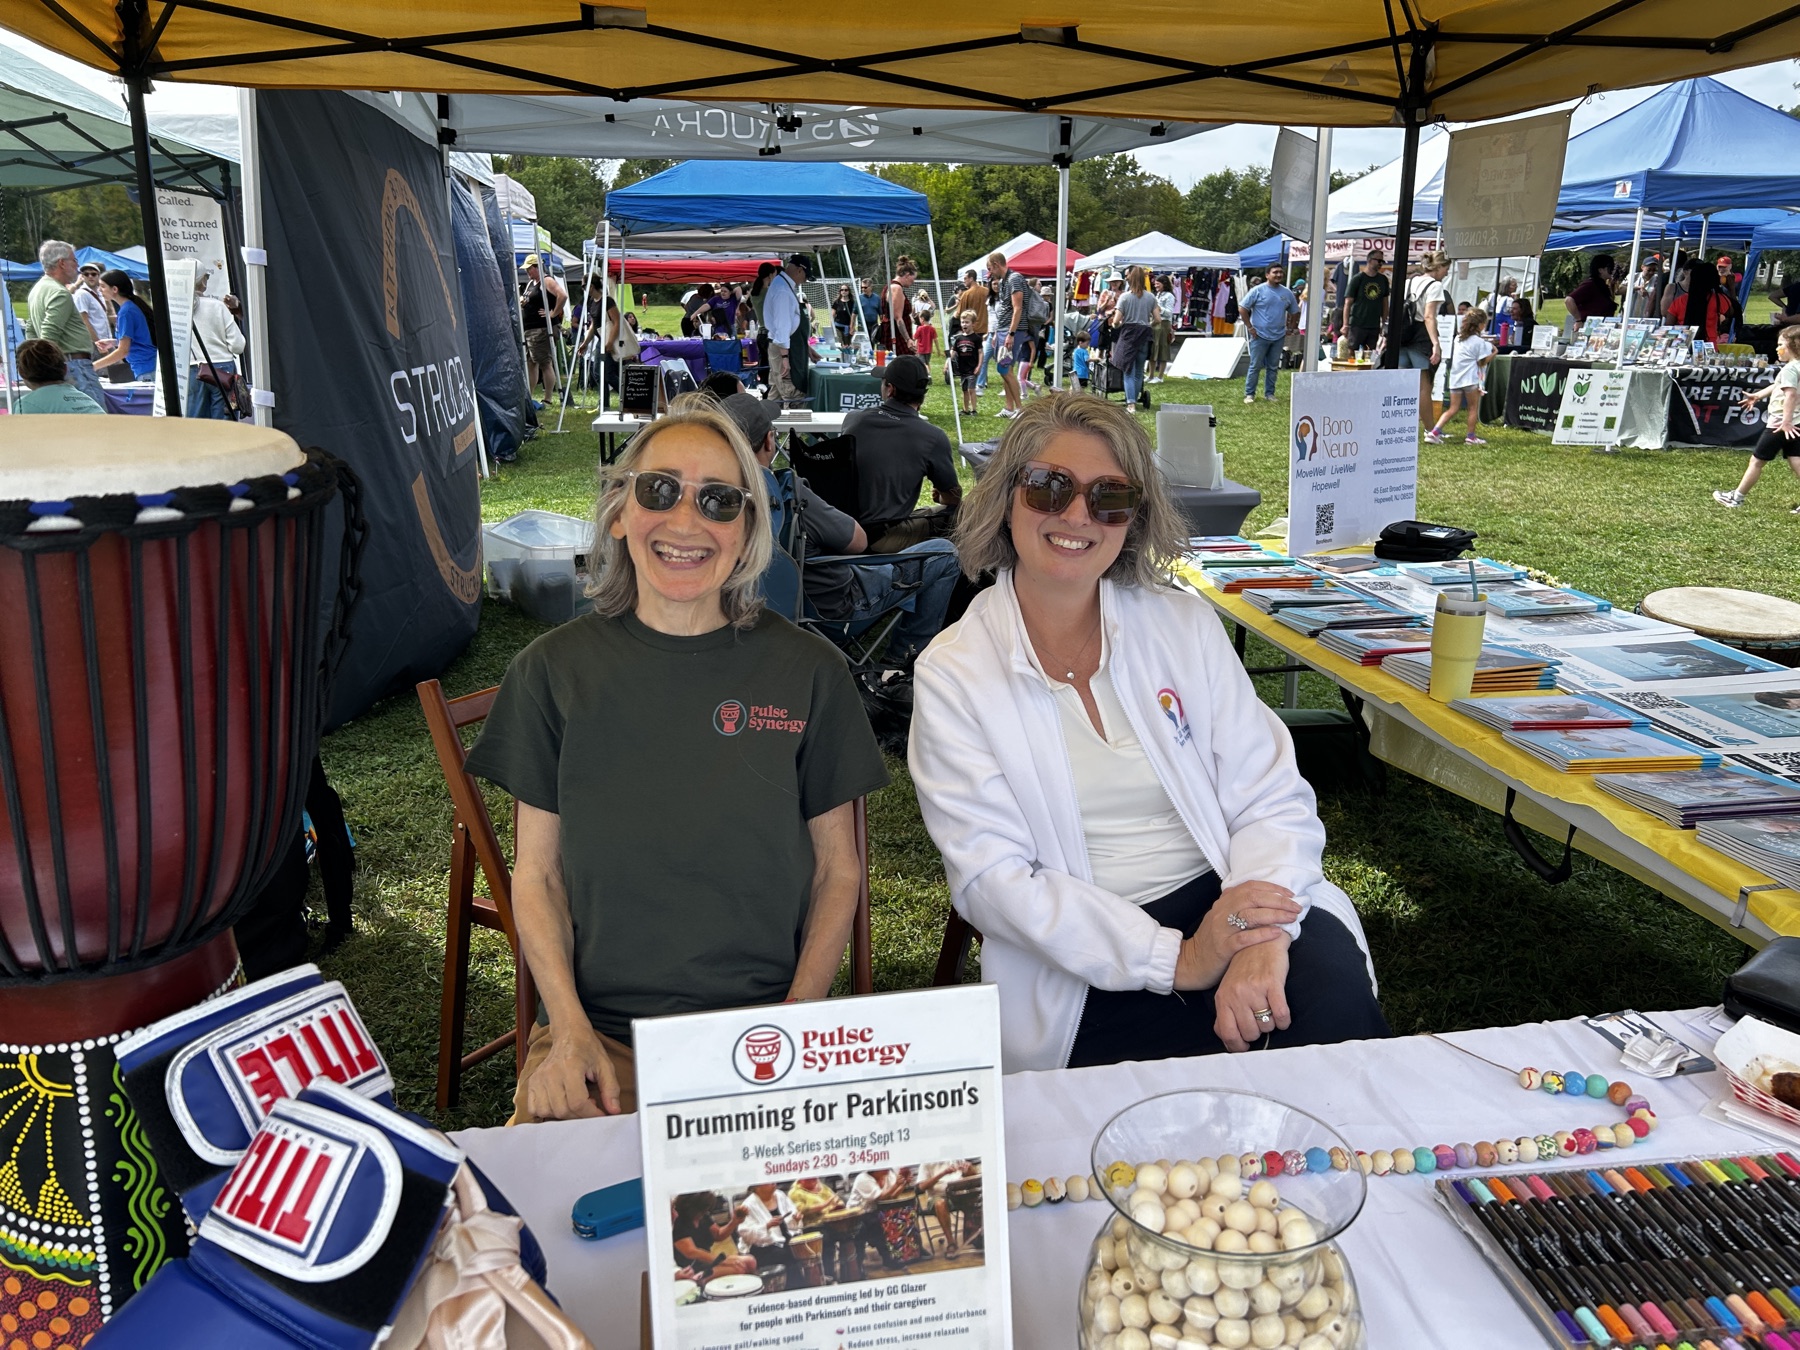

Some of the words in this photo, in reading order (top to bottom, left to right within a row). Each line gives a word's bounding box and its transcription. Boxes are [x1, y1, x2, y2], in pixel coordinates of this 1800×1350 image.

[158, 196, 194, 206] Called.
[160, 218, 178, 228] We
[178, 218, 218, 229] Turned
[162, 231, 180, 240] the
[182, 231, 210, 242] Light
[1362, 238, 1424, 251] DOUE
[164, 242, 198, 253] Down.
[1520, 375, 1537, 394] NJ
[1577, 373, 1594, 382] NJ
[1382, 396, 1392, 408] Jill
[1393, 396, 1417, 406] Farmer
[1382, 410, 1390, 419] DO,
[1391, 409, 1404, 418] MPH,
[1404, 408, 1417, 417] FCPP
[1723, 406, 1769, 426] FOO
[1322, 416, 1353, 436] Boro
[1322, 439, 1358, 459] Neuro
[1373, 456, 1415, 466] info@boroneuro.com
[1296, 466, 1326, 479] MoveWell
[1331, 463, 1356, 475] LiveWell
[1374, 465, 1415, 475] www.boroneuro.com
[1312, 479, 1340, 494] Hopewell
[1380, 486, 1388, 494] East
[1389, 484, 1401, 493] Broad
[750, 704, 788, 718] Pulse
[748, 716, 807, 733] Synergy
[802, 1026, 874, 1050] Pulse
[236, 1010, 379, 1116] TITLE
[802, 1042, 912, 1072] Synergy
[666, 1104, 796, 1140] Drumming
[804, 1098, 838, 1124] for
[846, 1081, 980, 1120] Parkinson's
[742, 1144, 785, 1161] 8-Week
[787, 1140, 821, 1156] Series
[824, 1135, 867, 1153] starting
[869, 1130, 894, 1148] Sept
[897, 1128, 910, 1142] 13
[764, 1158, 810, 1176] Sundays
[813, 1153, 838, 1168] 2:30
[849, 1149, 890, 1166] 3:45pm
[748, 1296, 813, 1316] Evidence-based
[815, 1291, 858, 1306] drumming
[859, 1288, 873, 1300] led
[874, 1287, 884, 1299] by
[901, 1283, 927, 1294] Glazer
[740, 1319, 752, 1331] for
[755, 1317, 783, 1331] people
[785, 1313, 803, 1324] with
[805, 1305, 852, 1322] Parkinson's
[854, 1305, 869, 1316] and
[871, 1302, 891, 1313] their
[893, 1296, 936, 1310] caregivers
[847, 1323, 871, 1334] Lessen
[873, 1318, 908, 1330] confusion
[909, 1316, 922, 1326] and
[924, 1314, 944, 1324] mood
[945, 1308, 987, 1321] disturbance
[734, 1336, 780, 1350] gait/walking
[782, 1332, 804, 1344] speed
[848, 1338, 874, 1349] Reduce
[876, 1334, 900, 1346] stress,
[902, 1331, 932, 1342] increase
[934, 1326, 970, 1338] relaxation
